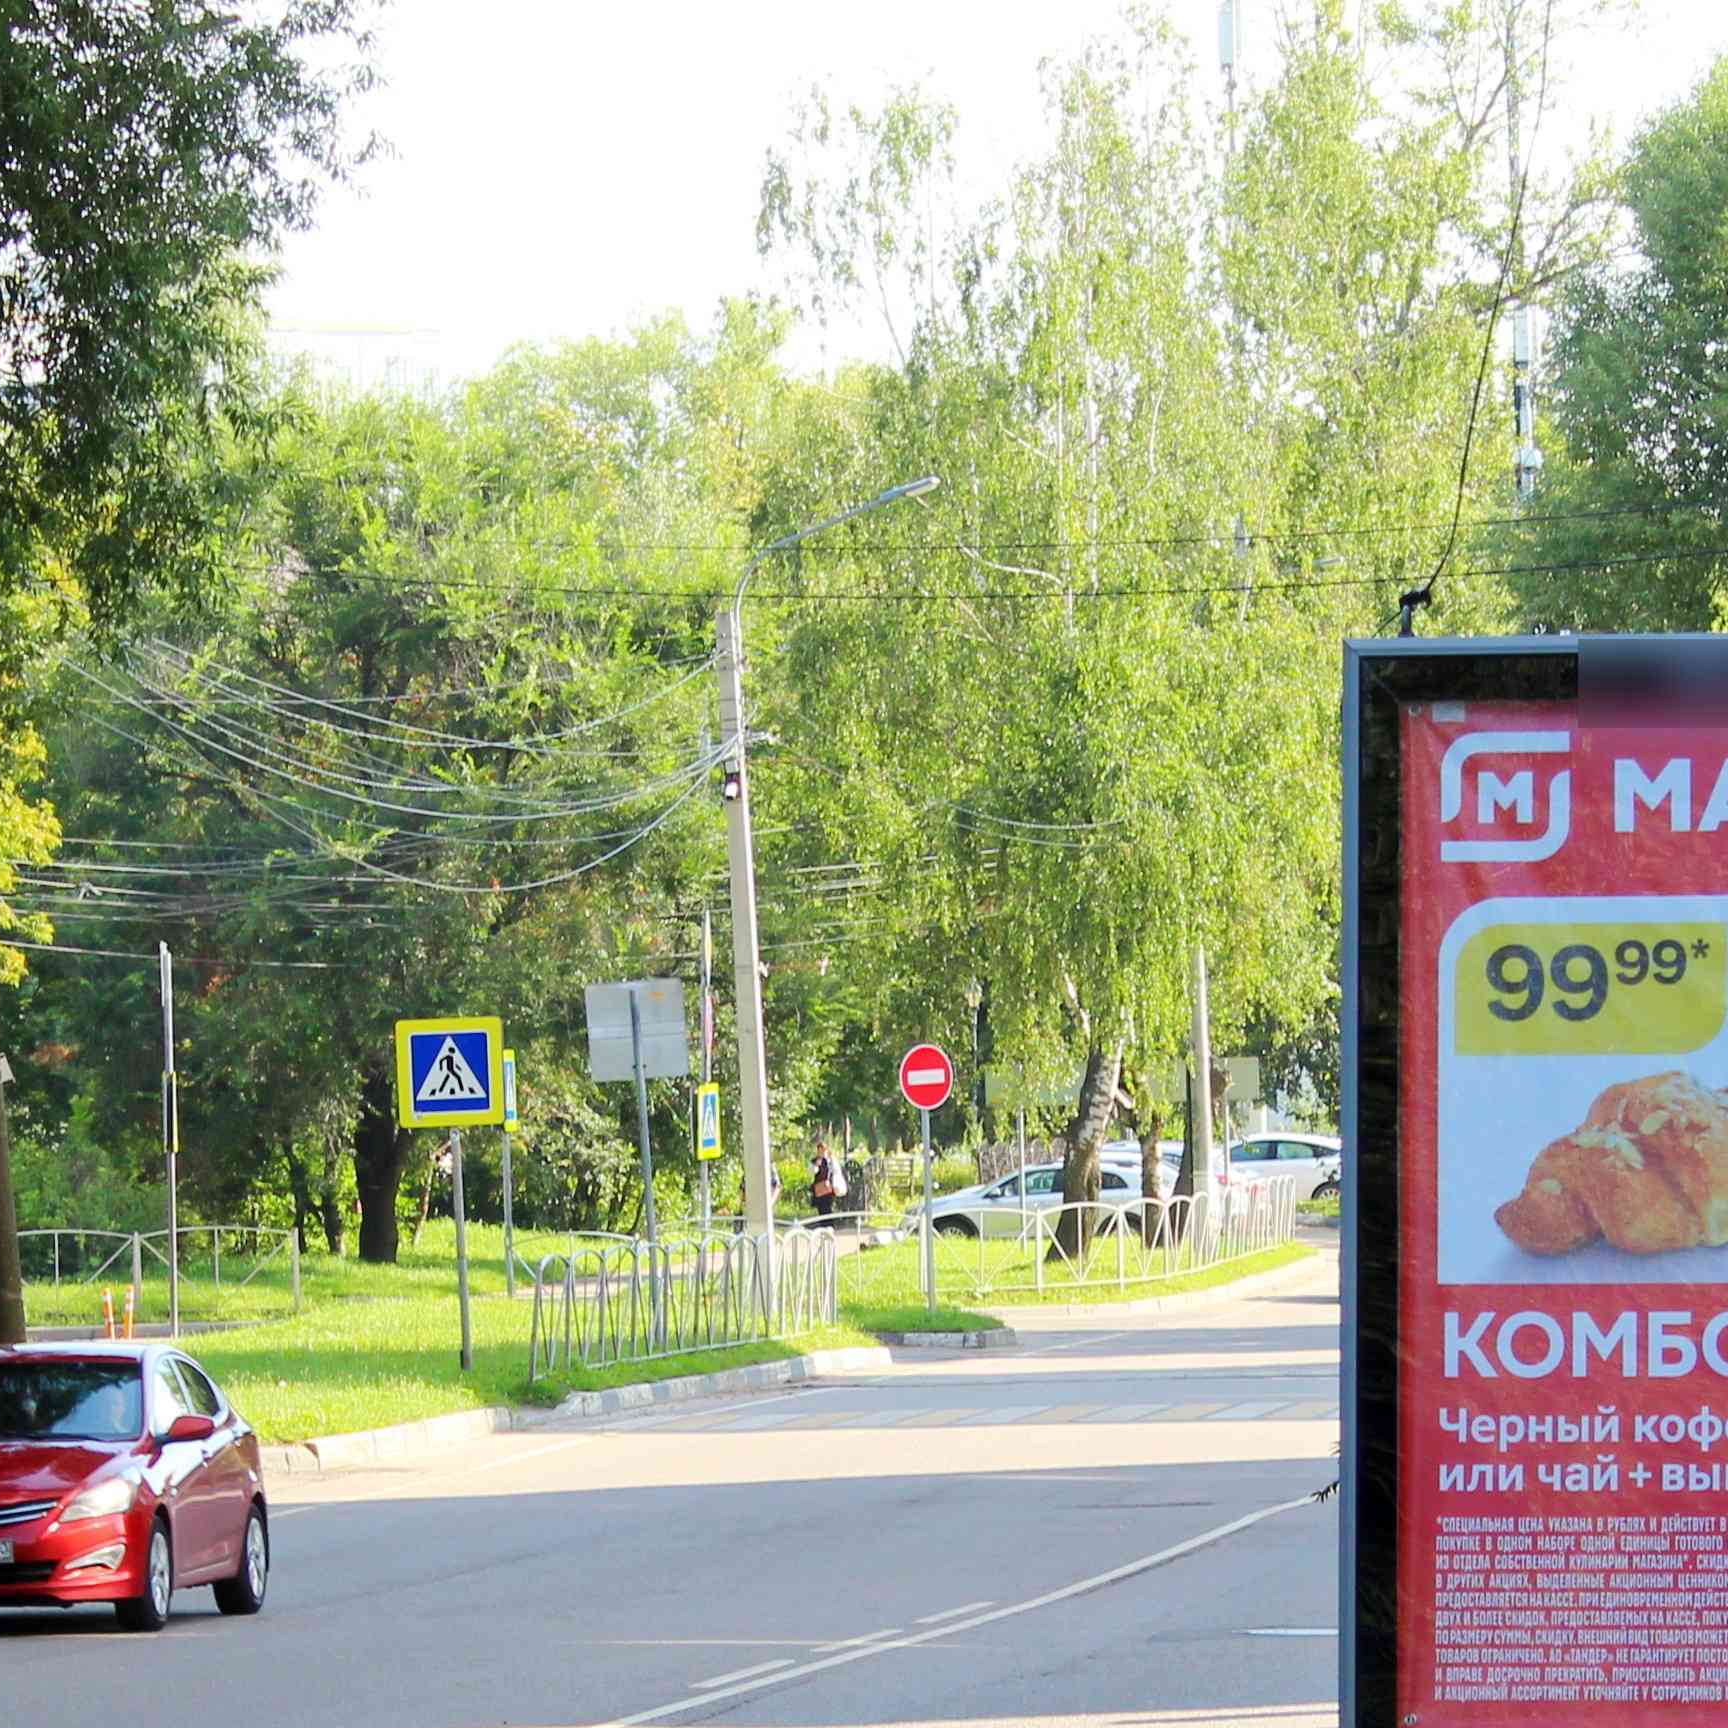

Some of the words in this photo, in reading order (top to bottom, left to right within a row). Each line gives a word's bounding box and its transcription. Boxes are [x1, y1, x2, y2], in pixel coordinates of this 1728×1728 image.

[1439, 1406, 1619, 1450] Черный
[1439, 1462, 1525, 1492] или
[1539, 1456, 1619, 1492] чай
[1629, 1468, 1653, 1491] +
[1519, 1516, 1544, 1533] ЦЕНА
[1549, 1516, 1592, 1531] УКАЗАНА
[1608, 1516, 1646, 1531] РУБЛЯХ
[1661, 1514, 1715, 1533] ДЕЙСТВУЕТ
[1435, 1536, 1480, 1550] ПОКУПКЕ
[1497, 1536, 1532, 1552] ОДНОМ
[1537, 1536, 1576, 1550] НАБОРЕ
[1581, 1534, 1615, 1552] ОДНОЙ
[1620, 1536, 1669, 1552] ЕДИНИЦЫ
[1675, 1536, 1723, 1550] ГОТОВОГО
[1453, 1555, 1490, 1571] ОТДЕЛА
[1494, 1552, 1565, 1569] СОБСТВЕННОЙ
[1569, 1554, 1628, 1569] КУЛИНАРИИ
[1446, 1574, 1484, 1590] ДРУГИХ
[1536, 1574, 1604, 1590] ВЫДЕЛЕННЫЕ
[1609, 1573, 1673, 1589] АКЦИОННЫМ
[1435, 1611, 1463, 1627] ДВУХ
[1472, 1611, 1503, 1625] БОЛЕЕ
[1551, 1611, 1648, 1627] ПРЕДОСТАВЛЯЕМЫХ
[1435, 1649, 1479, 1663] ТОВАРОВ
[1481, 1649, 1546, 1663] ОГРАНИЧЕНО.
[1630, 1648, 1695, 1663] ГАРАНТИРУЕТ
[1446, 1667, 1483, 1682] ВПРАВЕ
[1487, 1667, 1540, 1684] ДОСРОЧНО
[1612, 1667, 1696, 1682] ПРИОСТАНОВИТЬ
[1444, 1684, 1508, 1703] АКЦИОННЫЙ
[1511, 1686, 1580, 1701] АССОРТИМЕНТ
[1583, 1684, 1639, 1701] УТОЧНЯЙТЕ
[1651, 1686, 1722, 1702] СОТРУДНИКОВ
